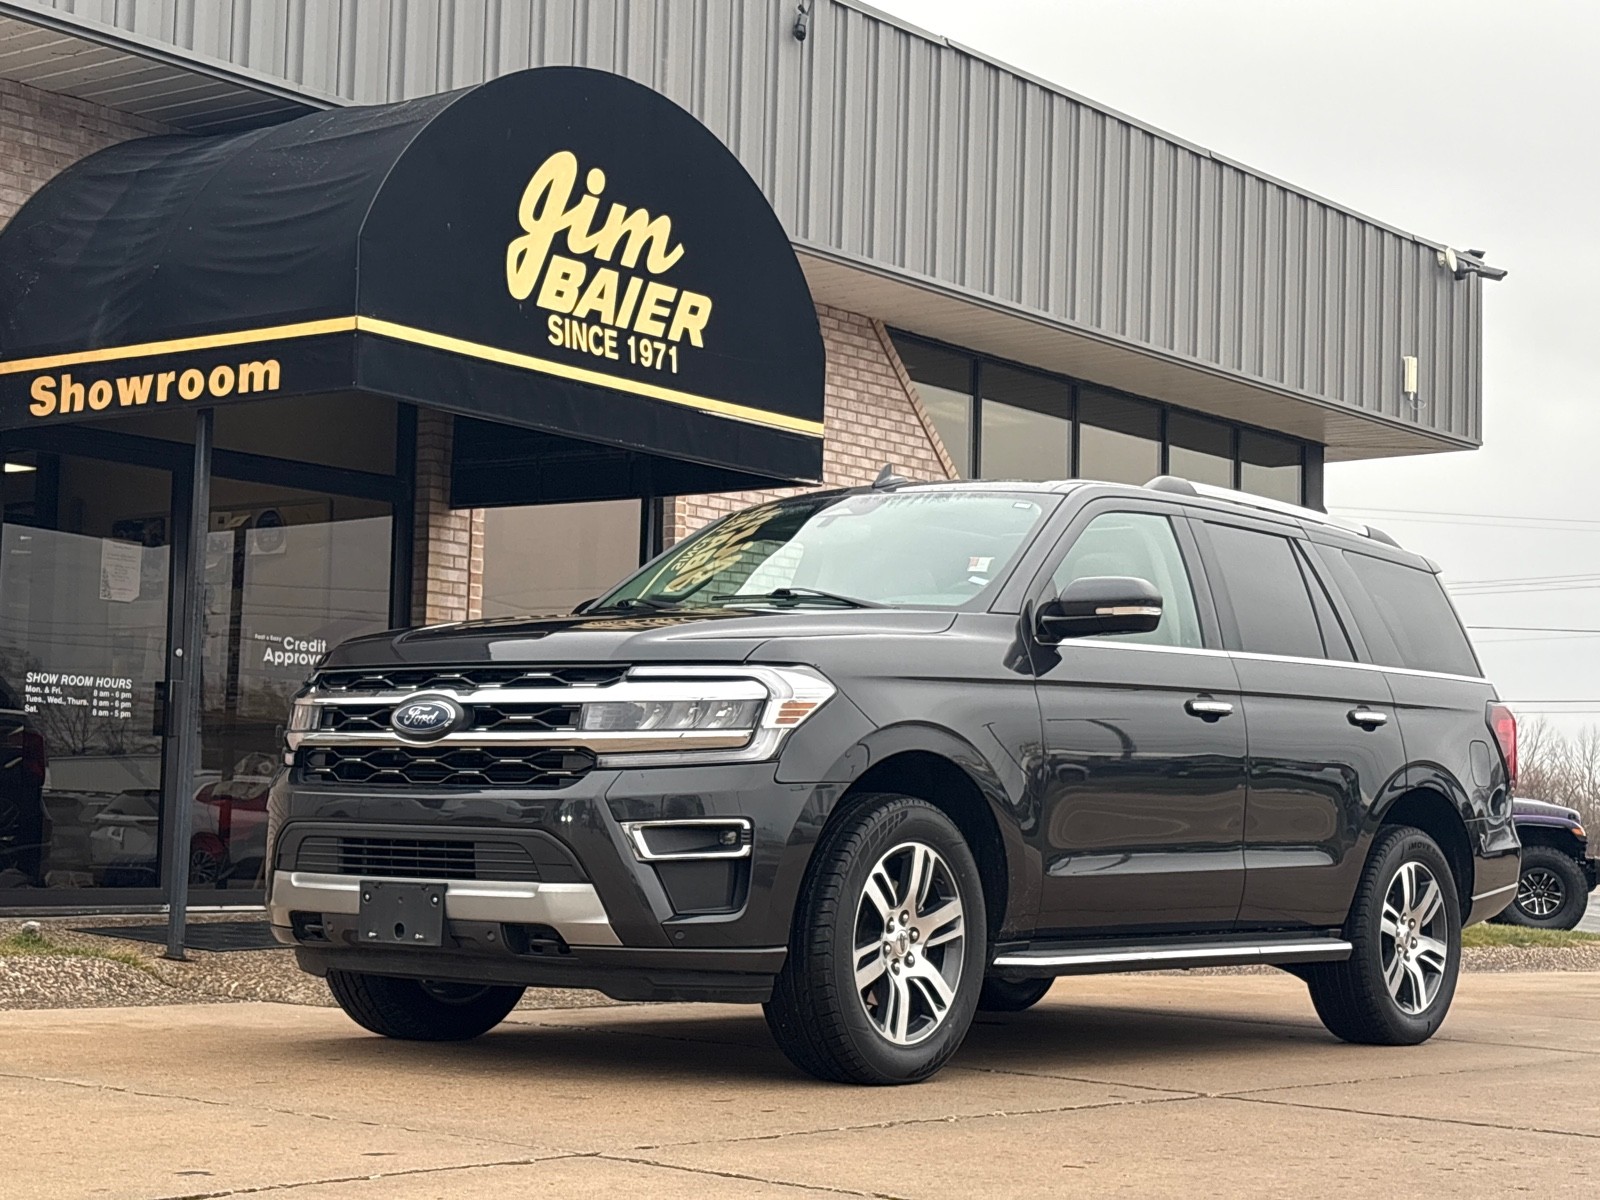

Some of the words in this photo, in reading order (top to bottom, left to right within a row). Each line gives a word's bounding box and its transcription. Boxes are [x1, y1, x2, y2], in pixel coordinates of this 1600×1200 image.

[506, 150, 685, 300] Jim
[536, 254, 712, 348] BAIER
[547, 314, 619, 360] SINCE
[627, 335, 677, 374] 1971
[29, 359, 281, 417] Showroom
[283, 636, 326, 653] Credit
[26, 672, 58, 684] SHOW
[61, 674, 93, 687] ROOM
[96, 677, 132, 689] HOURS
[26, 685, 42, 693] Mon.
[52, 686, 62, 695] Fri.
[121, 691, 132, 699] pm
[25, 704, 38, 713] Sat.
[98, 709, 109, 717] am
[120, 711, 131, 719] pm
[68, 697, 89, 706] Thurs.
[121, 701, 131, 709] pm
[403, 706, 439, 725] Ford
